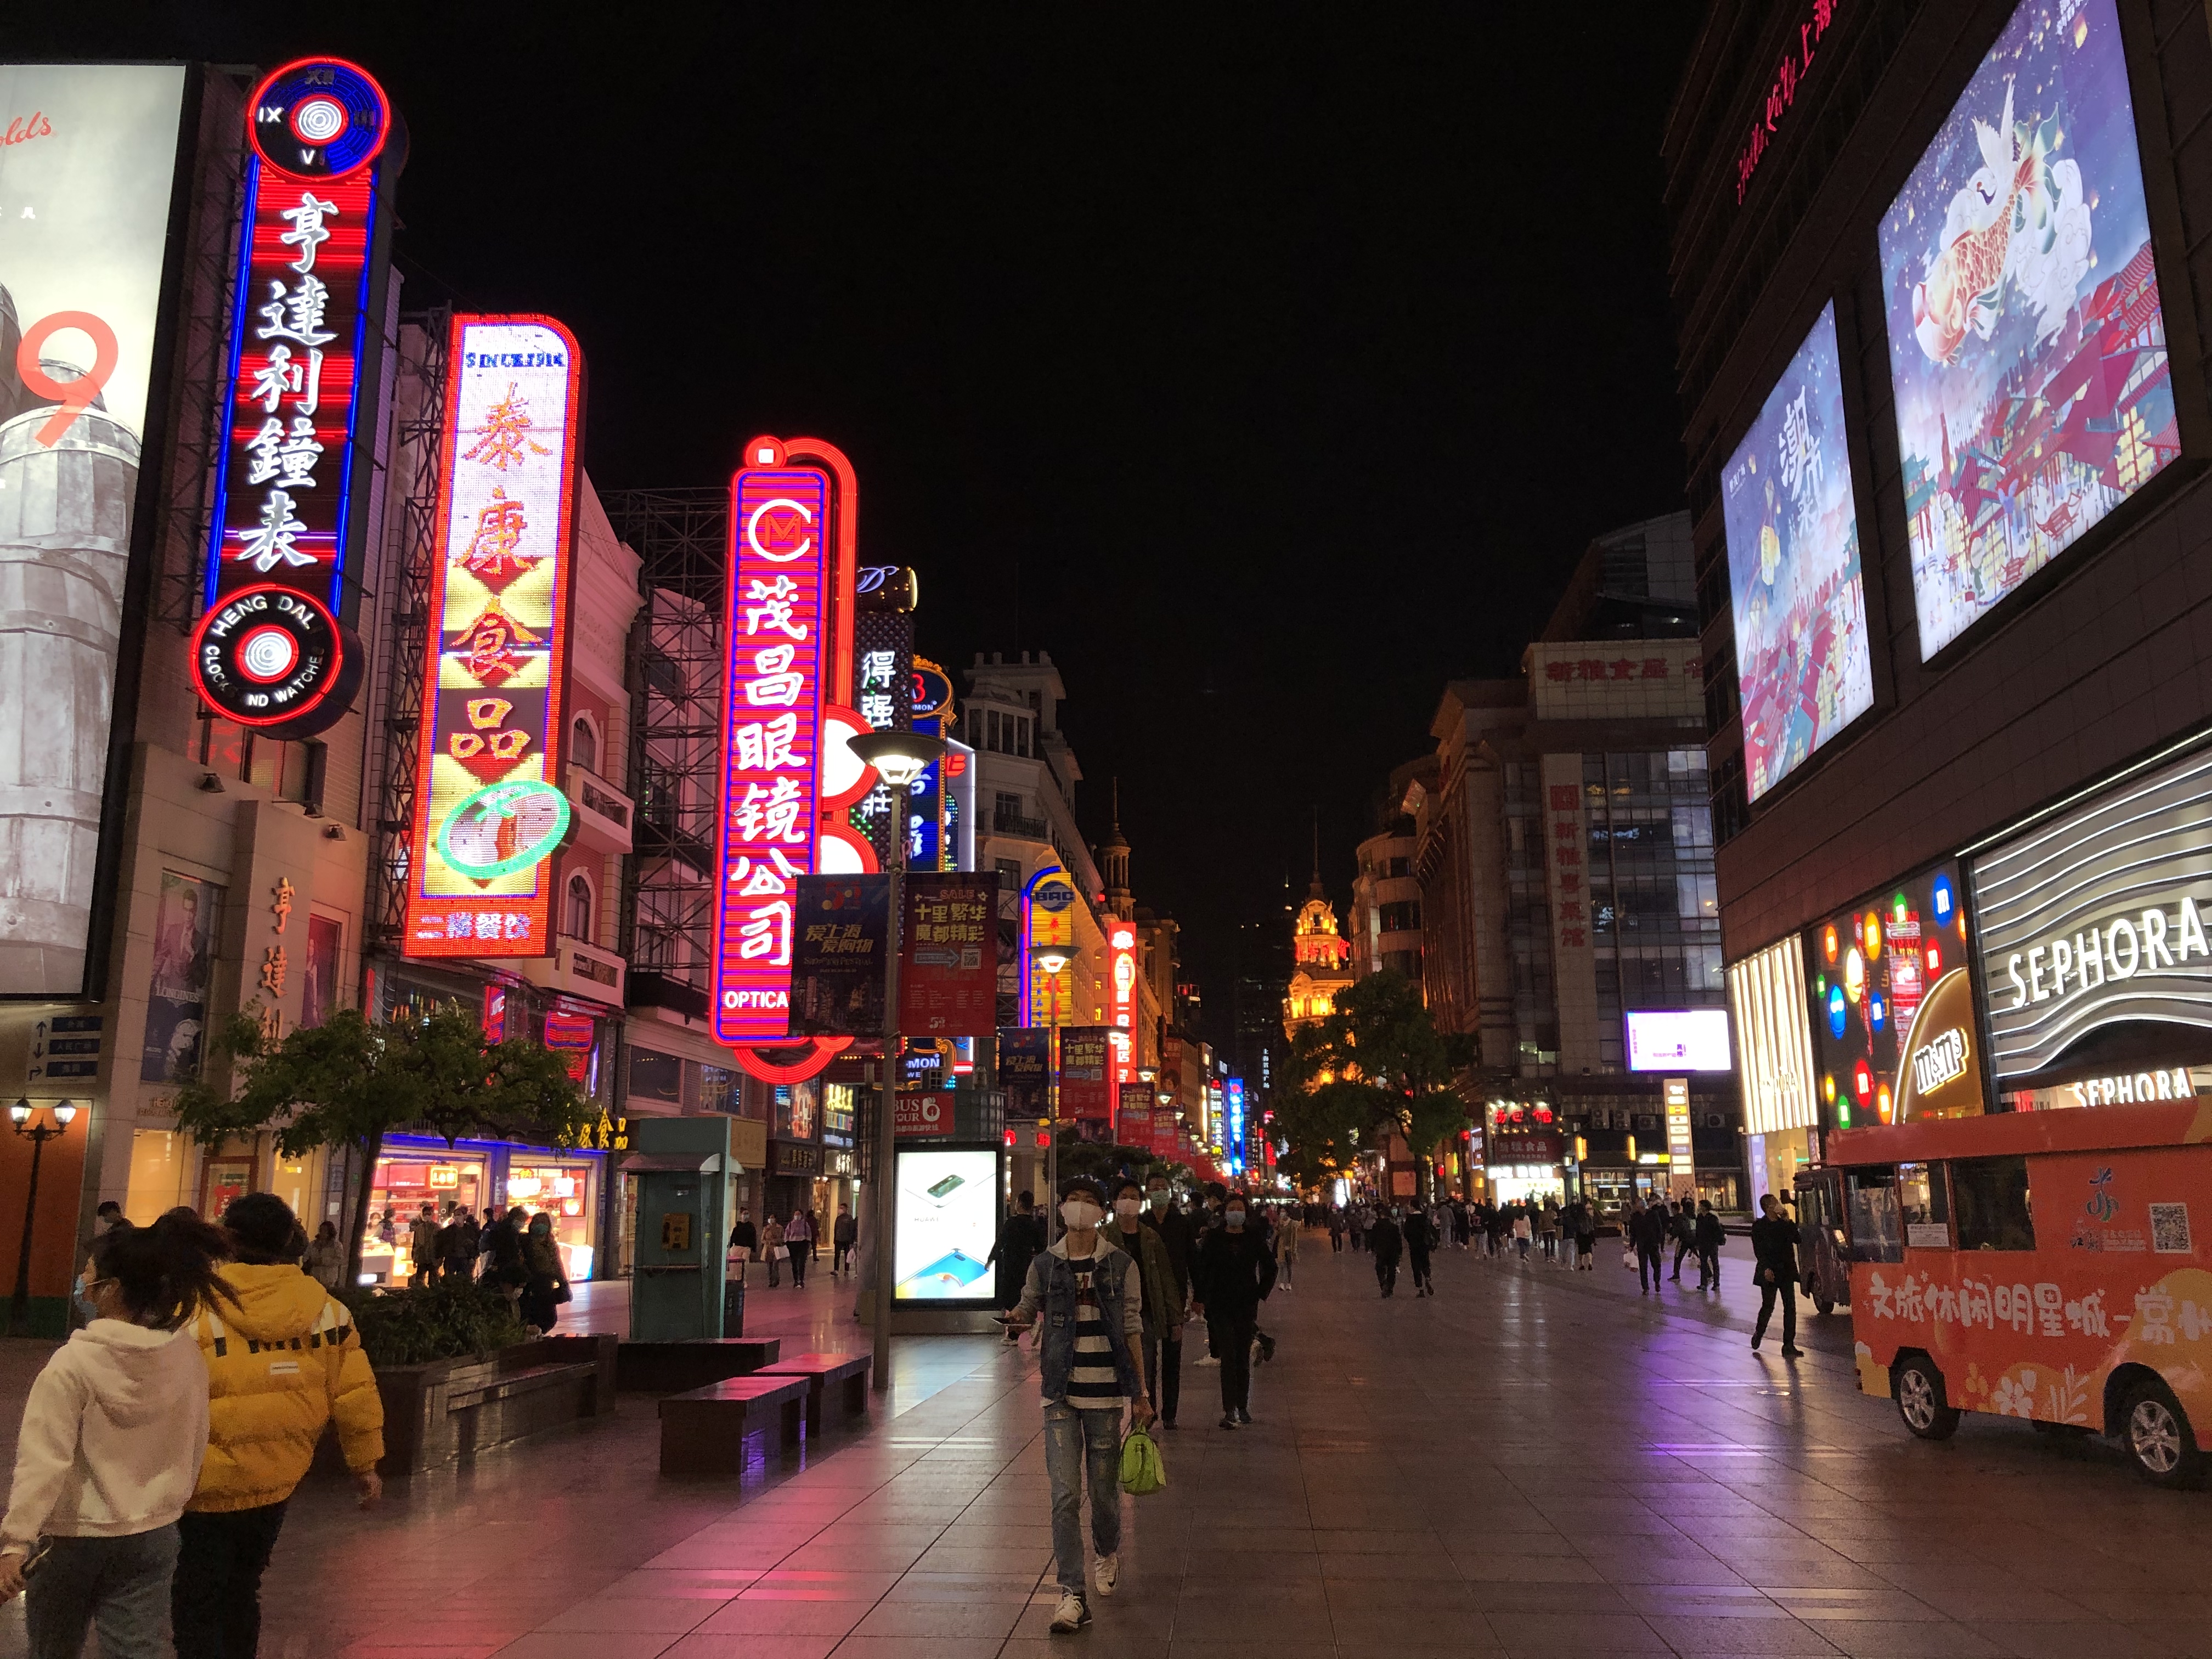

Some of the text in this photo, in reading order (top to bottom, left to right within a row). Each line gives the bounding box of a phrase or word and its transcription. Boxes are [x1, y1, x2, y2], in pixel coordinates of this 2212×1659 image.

[258, 106, 285, 123] IX
[448, 381, 553, 760] 泰康食品
[211, 595, 268, 637] HENG
[730, 575, 808, 966] 茂昌眼镜公司
[914, 902, 987, 923] 十里繁华
[805, 923, 863, 941] 爱上海
[915, 924, 985, 943] 魔都精彩
[821, 938, 874, 953] 爱购物
[2008, 896, 2212, 1008] SEPHORA
[155, 980, 200, 1003] LONGINES
[2073, 1068, 2192, 1108] SEPHORA
